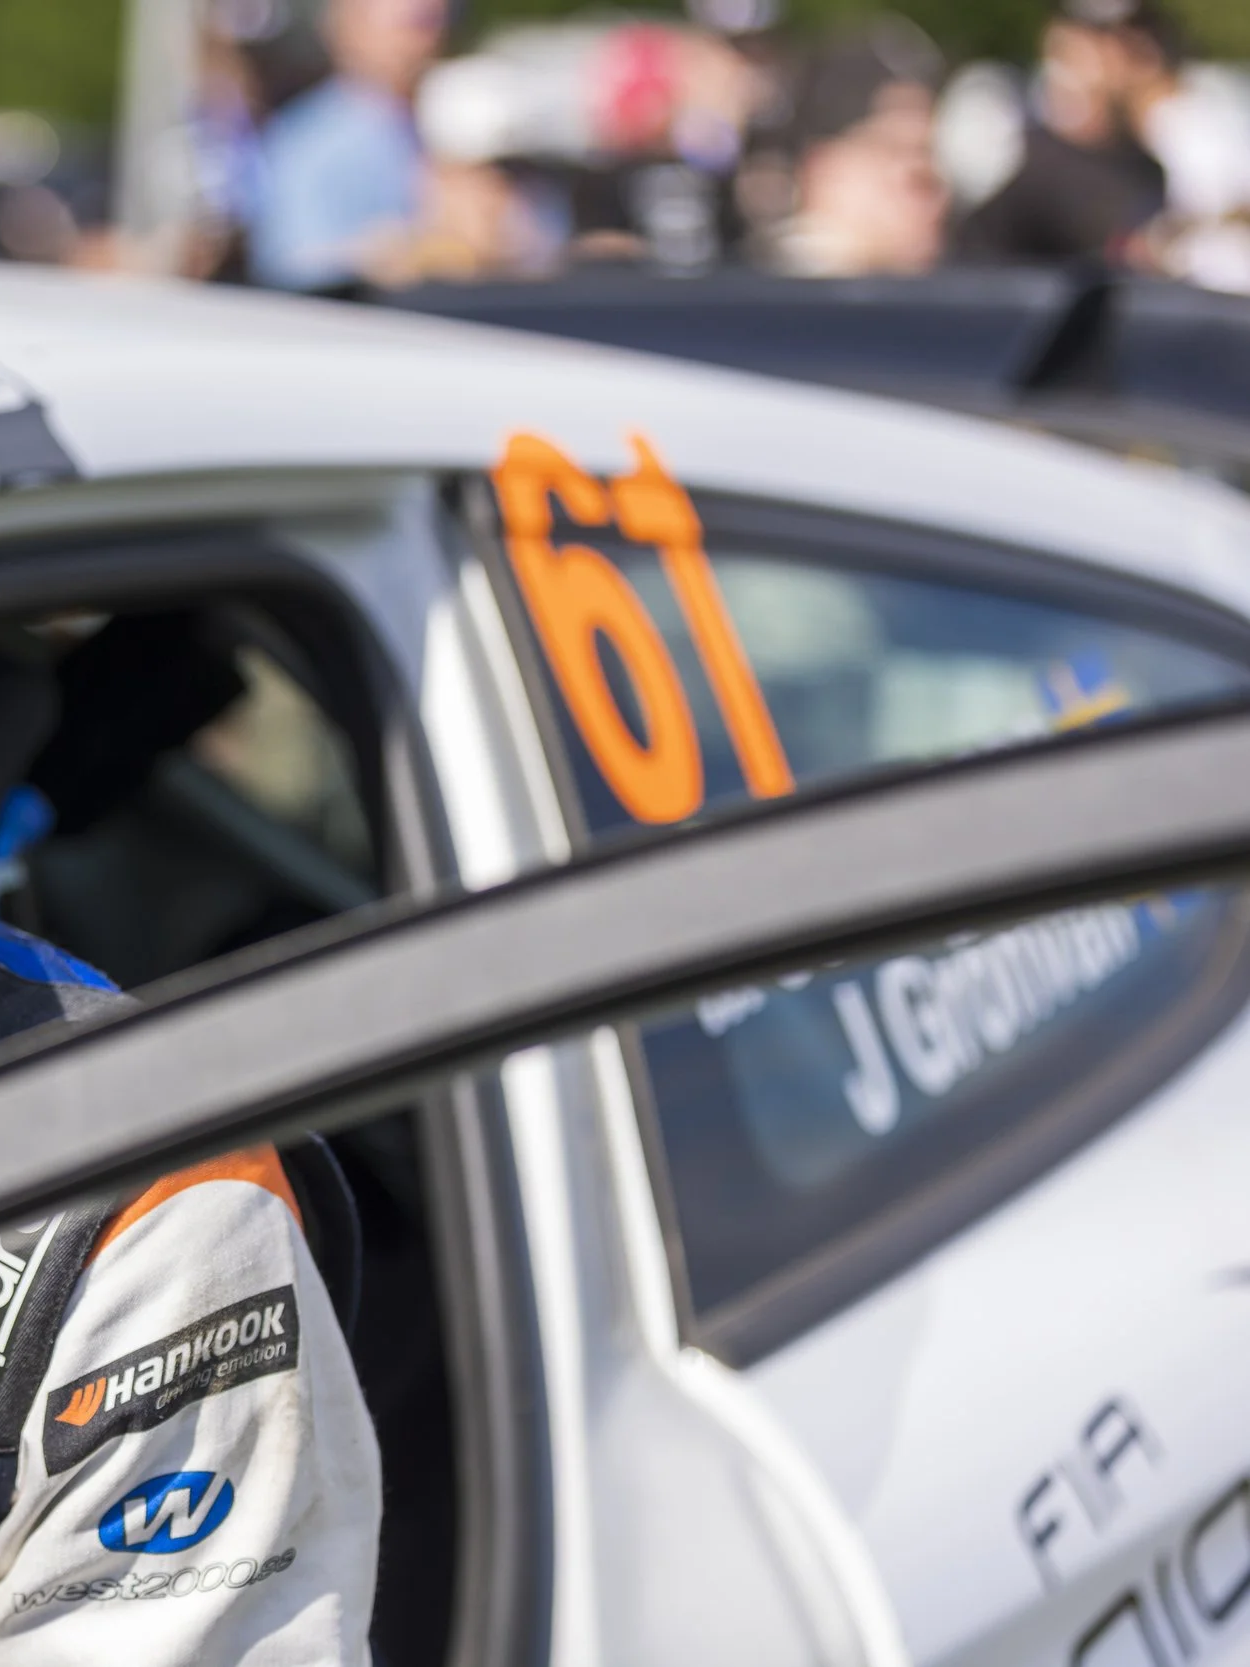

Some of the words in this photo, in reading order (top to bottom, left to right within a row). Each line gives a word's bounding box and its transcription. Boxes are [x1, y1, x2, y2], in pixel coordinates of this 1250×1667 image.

[492, 433, 796, 824] 61
[155, 1365, 213, 1410] driving
[216, 1340, 288, 1378] emotion
